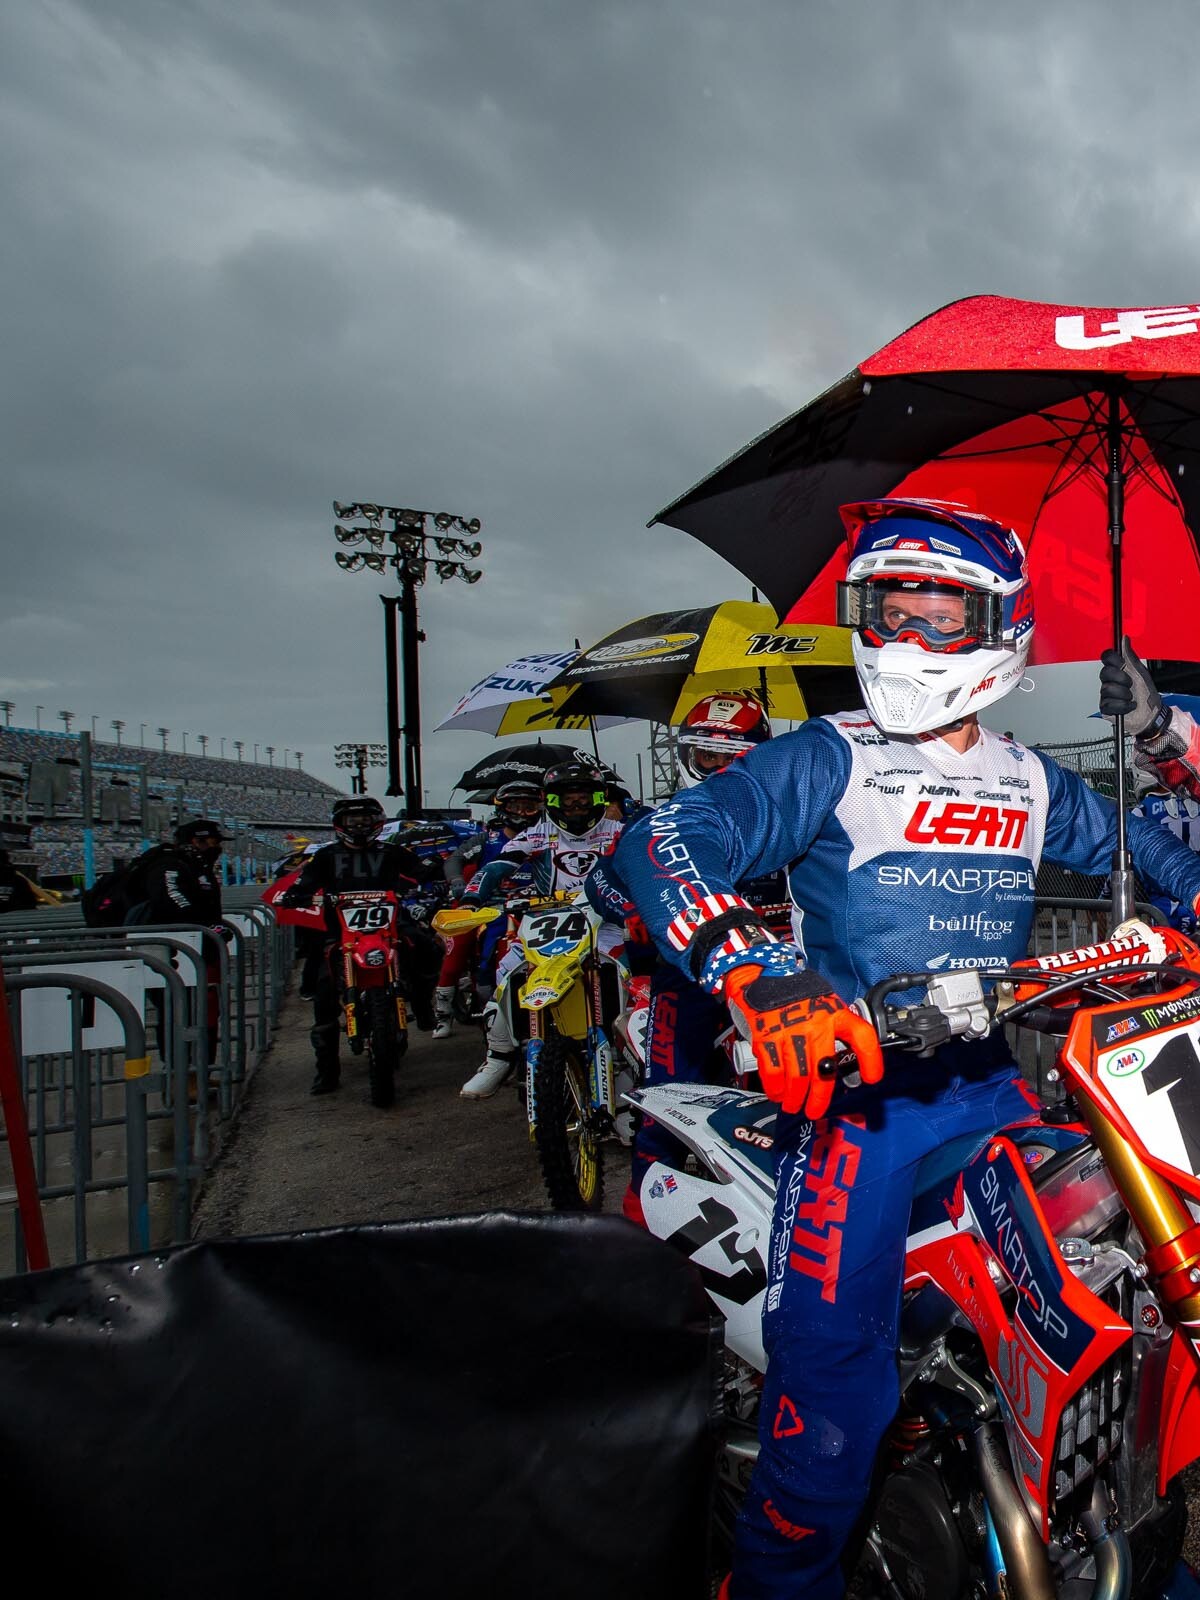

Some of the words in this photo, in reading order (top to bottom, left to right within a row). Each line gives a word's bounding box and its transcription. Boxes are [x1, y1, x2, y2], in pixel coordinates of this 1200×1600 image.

[899, 541, 923, 550] LEATT
[904, 801, 1029, 849] LEATT
[333, 852, 384, 878] FLY
[995, 893, 1002, 902] by
[349, 907, 389, 928] 49
[929, 911, 1014, 936] bullfrog
[527, 912, 588, 947] 34
[983, 932, 1003, 942] spas
[949, 957, 1008, 969] HONDA
[651, 991, 680, 1077] LEATT
[1106, 1016, 1141, 1042] AMA
[1115, 1052, 1139, 1072] AMA
[601, 1050, 610, 1101] DUNLOP
[668, 1110, 697, 1127] DUNLOP
[733, 1126, 775, 1149] GUTS
[662, 1174, 678, 1194] AMA
[762, 1499, 816, 1542] LEATT
